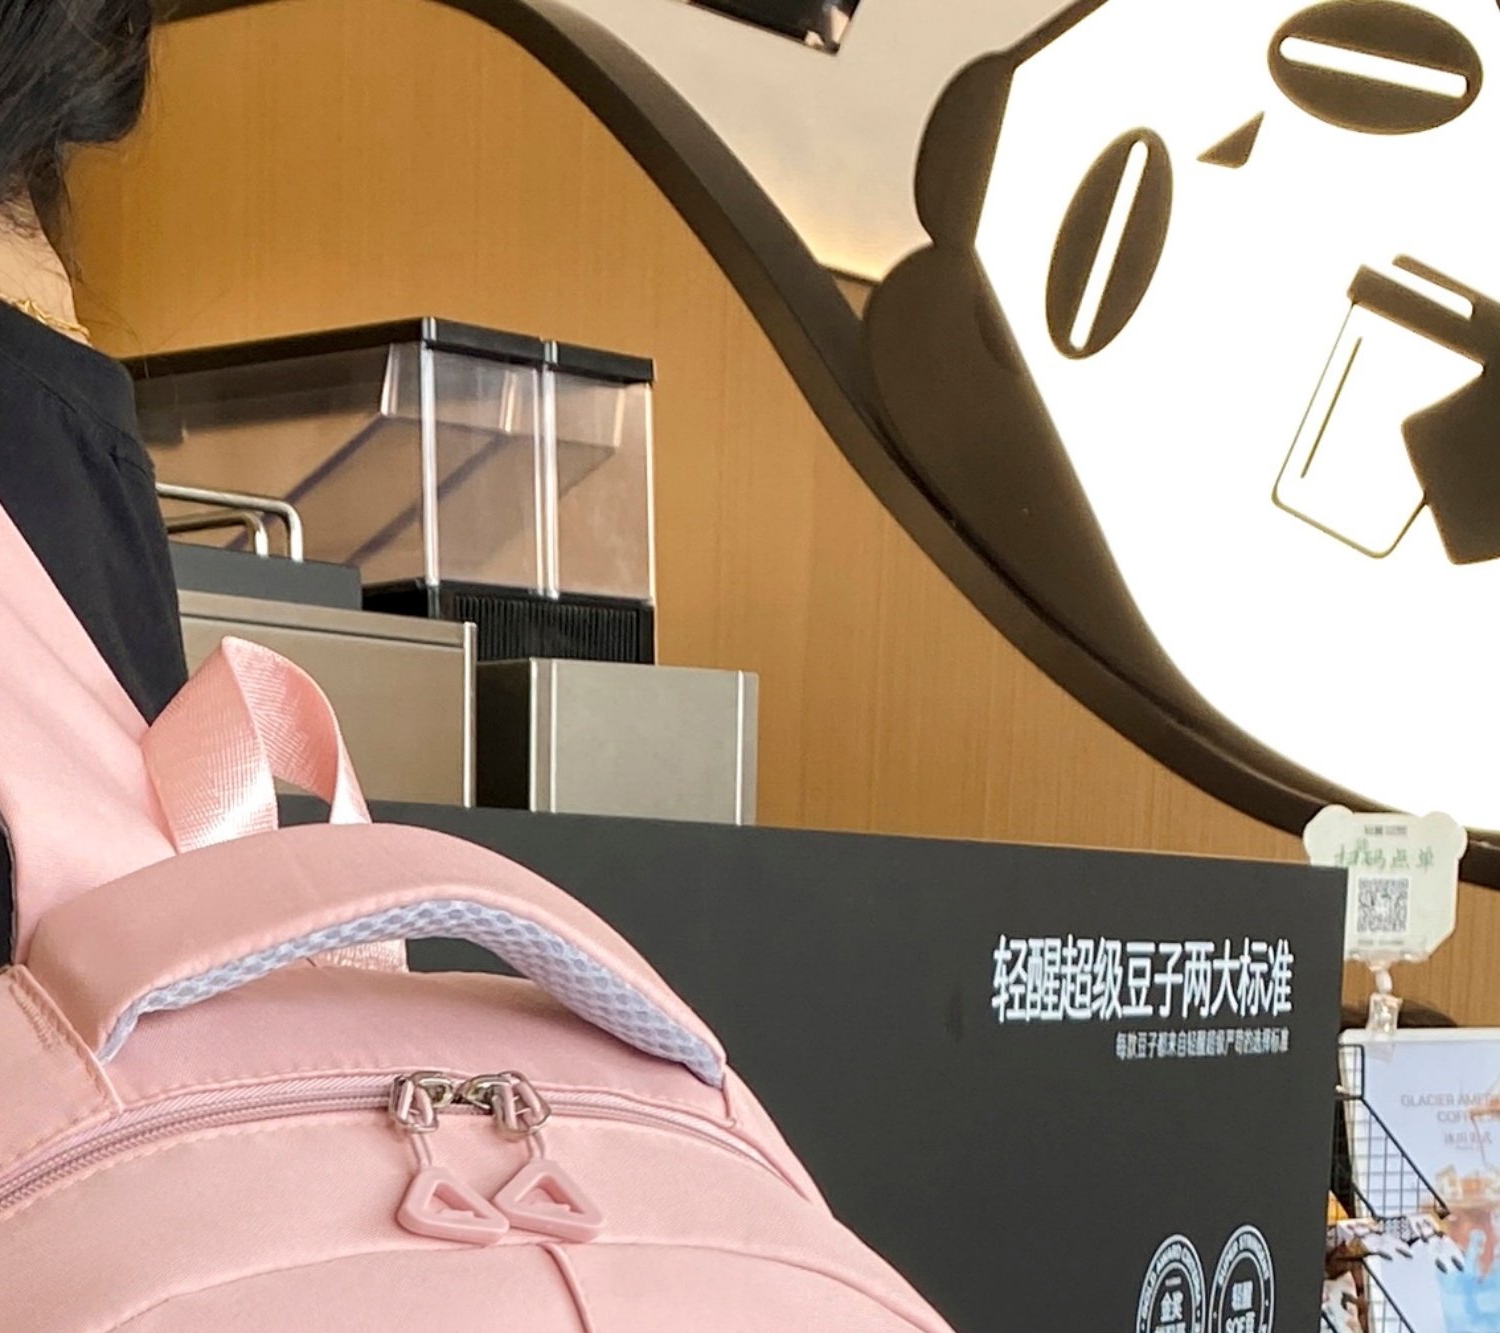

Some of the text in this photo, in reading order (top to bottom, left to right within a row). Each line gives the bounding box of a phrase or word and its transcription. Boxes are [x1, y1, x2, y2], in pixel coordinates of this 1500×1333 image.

[992, 933, 1295, 1024] 轻醒超级豆子两大标准
